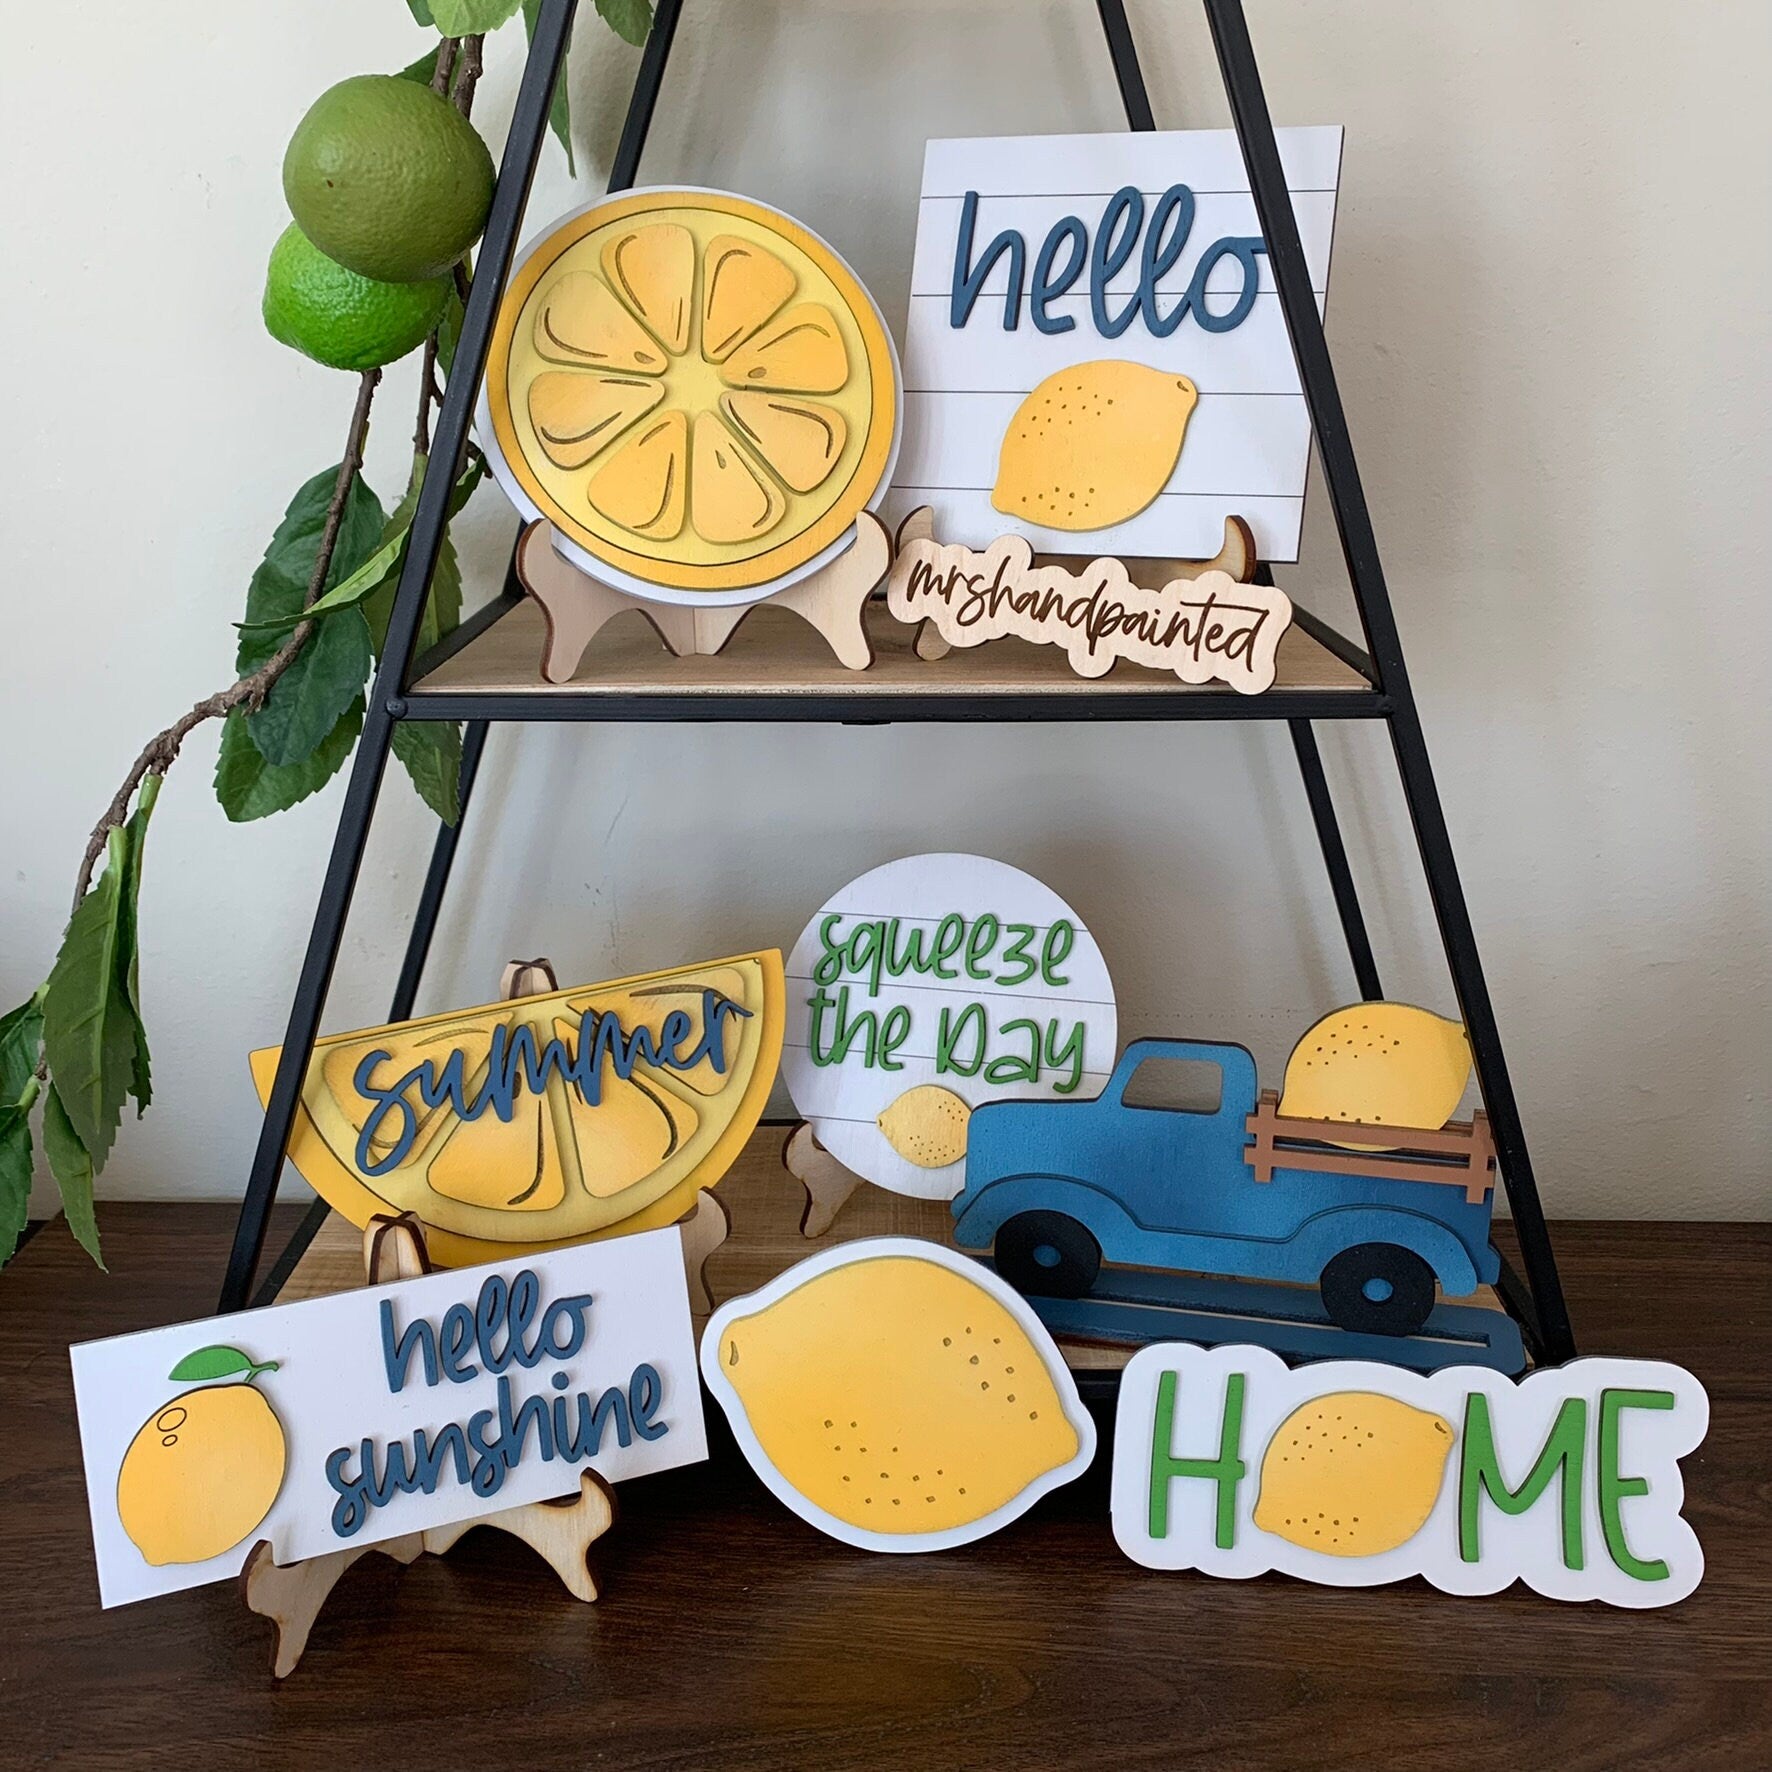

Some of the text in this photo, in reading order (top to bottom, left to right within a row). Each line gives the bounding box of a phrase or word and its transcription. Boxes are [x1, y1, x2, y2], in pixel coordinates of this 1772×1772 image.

[951, 183, 1270, 338] hello
[906, 554, 1270, 673] mrshandpainted
[812, 911, 1076, 997] squeeze
[353, 988, 754, 1177] summer
[806, 985, 915, 1072] the
[379, 1269, 593, 1394] hello
[325, 1363, 669, 1538] sunshine
